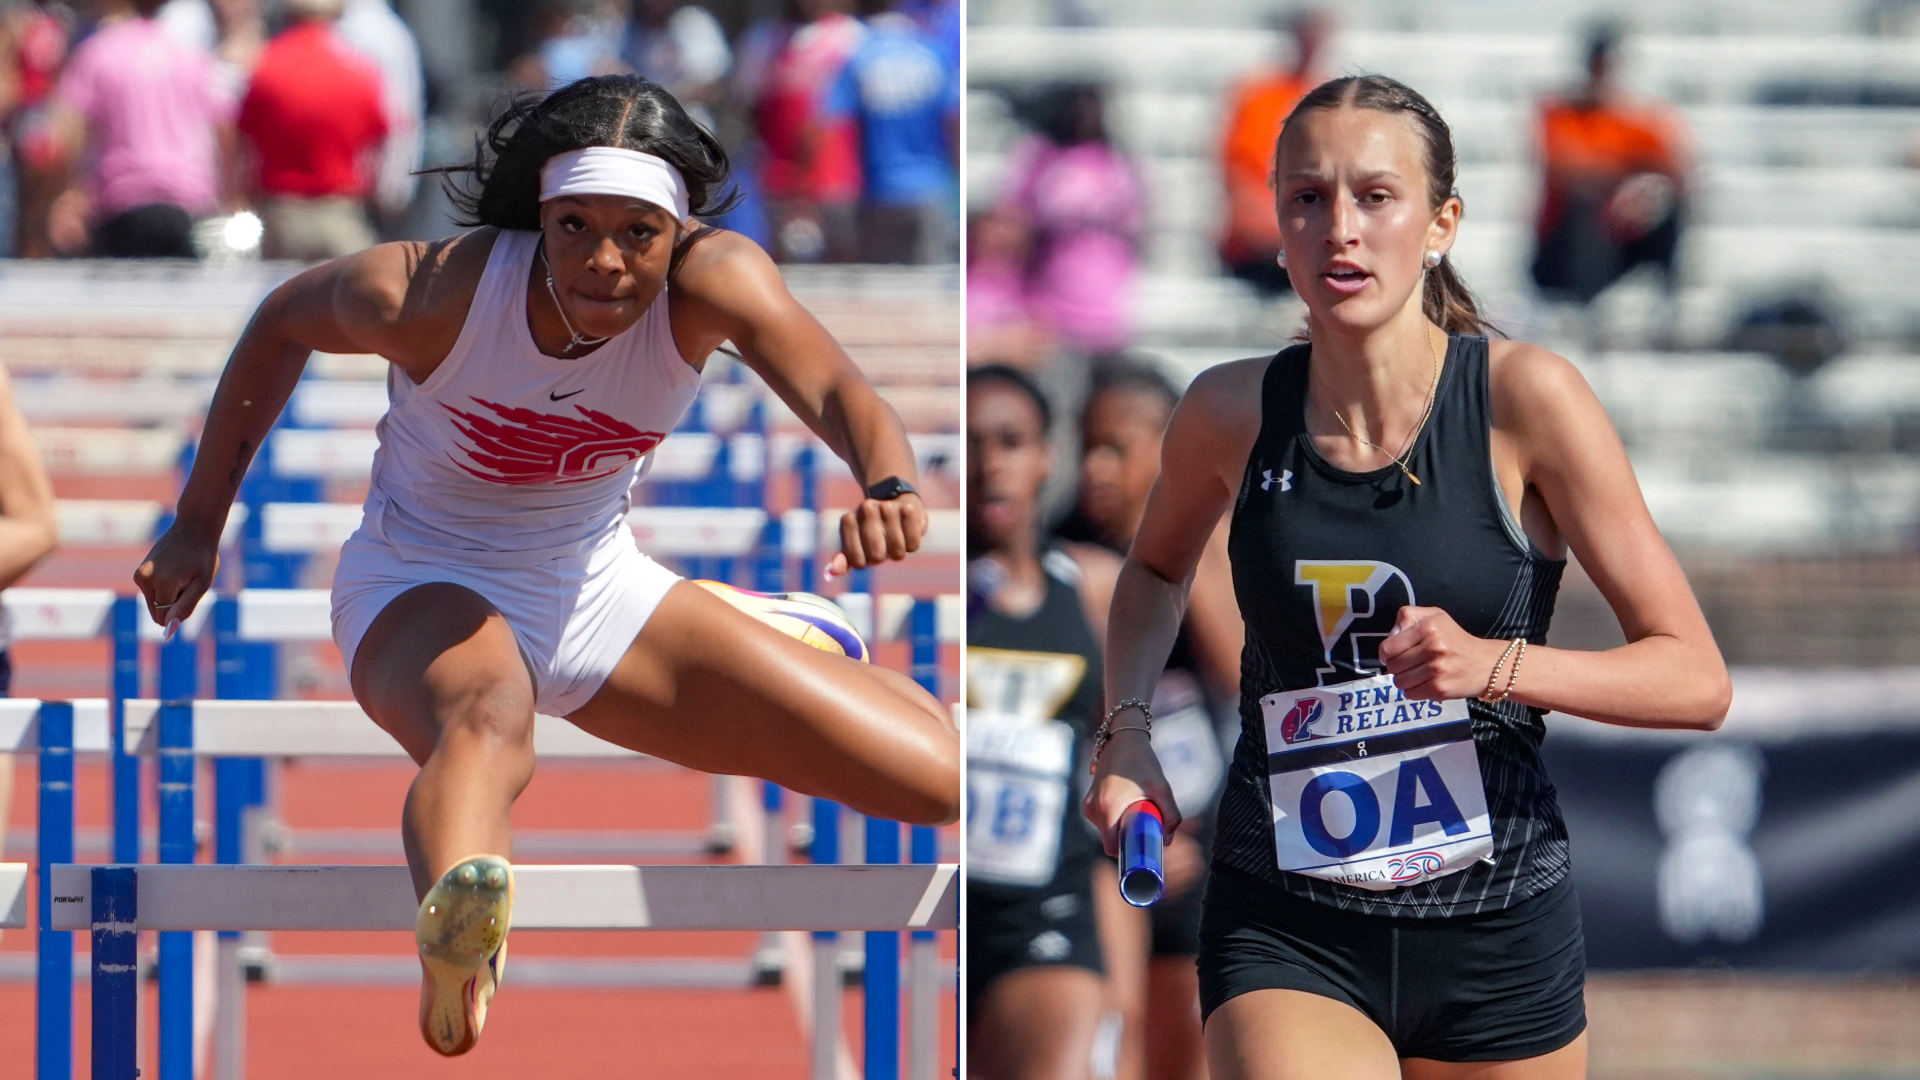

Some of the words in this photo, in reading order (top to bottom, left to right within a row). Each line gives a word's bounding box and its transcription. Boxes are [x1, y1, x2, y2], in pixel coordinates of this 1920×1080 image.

[1336, 700, 1443, 734] RELAYS
[1300, 756, 1471, 859] OA
[1387, 851, 1445, 884] 250
